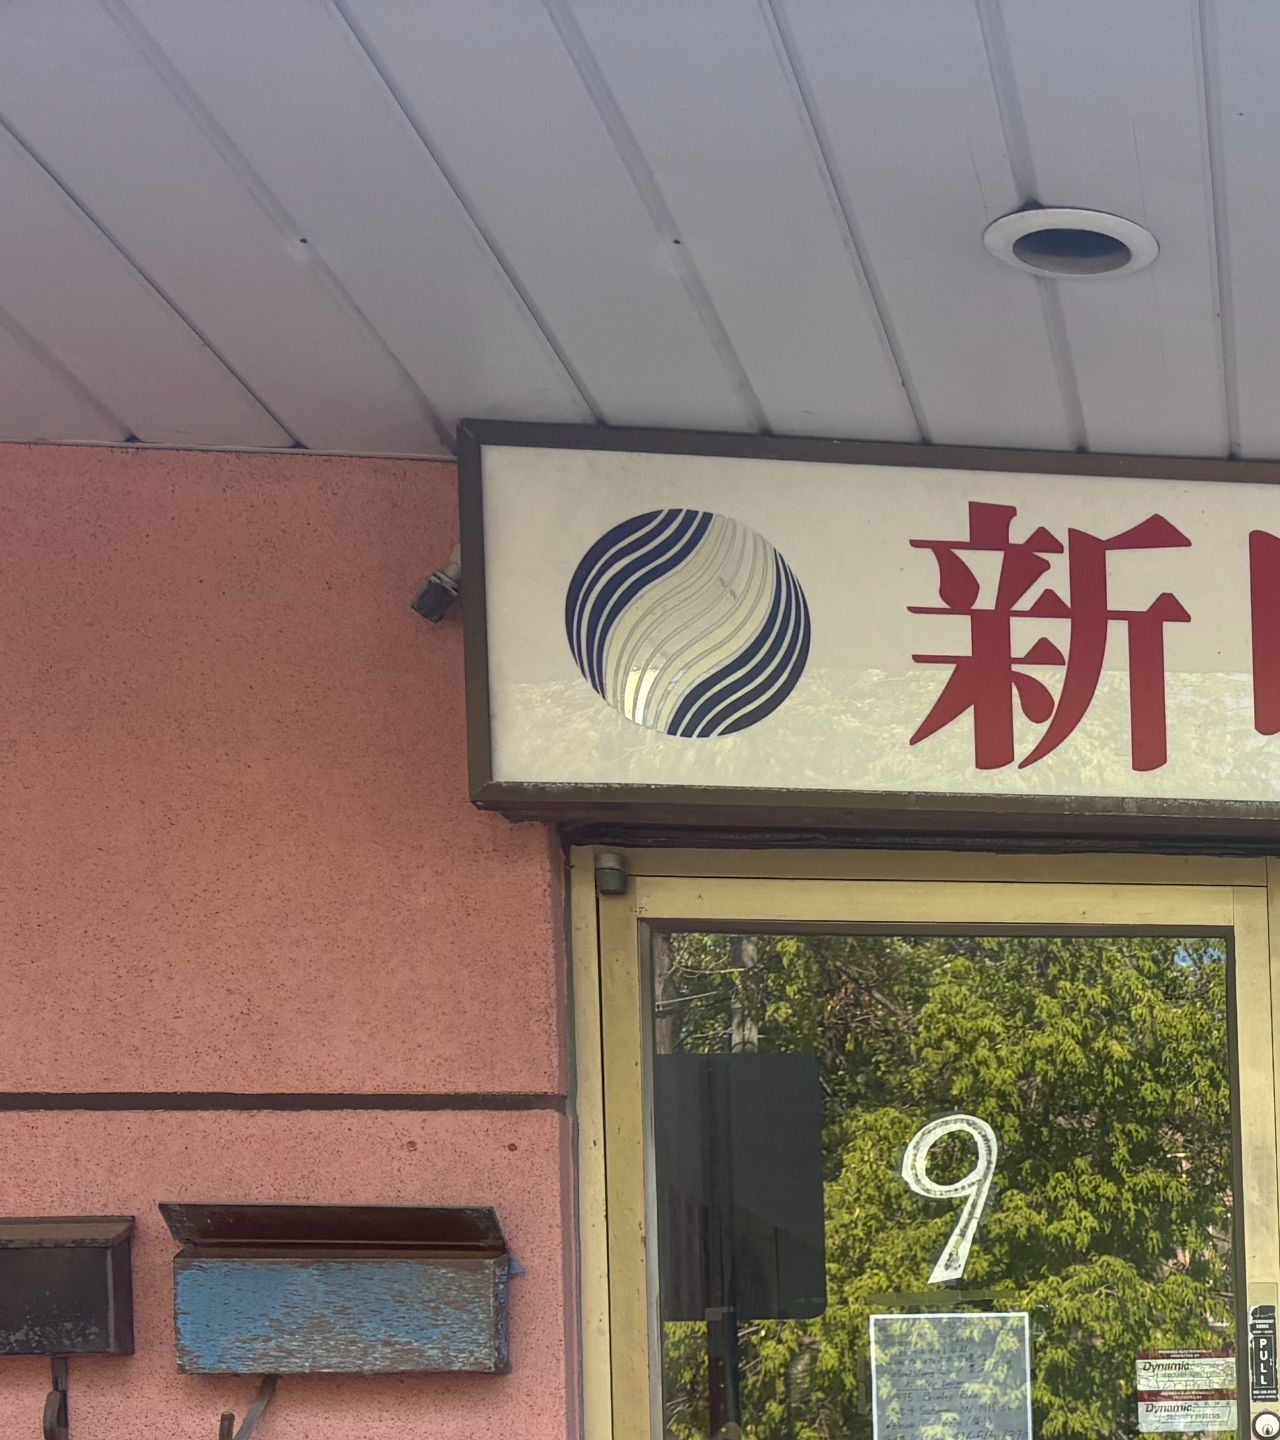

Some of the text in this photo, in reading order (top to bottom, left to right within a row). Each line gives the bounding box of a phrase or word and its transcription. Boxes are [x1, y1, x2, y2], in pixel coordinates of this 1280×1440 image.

[901, 1114, 998, 1284] 9
[1143, 1361, 1191, 1373] Dynamic
[1259, 1338, 1269, 1386] PULL
[1145, 1403, 1193, 1414] Dynamic
